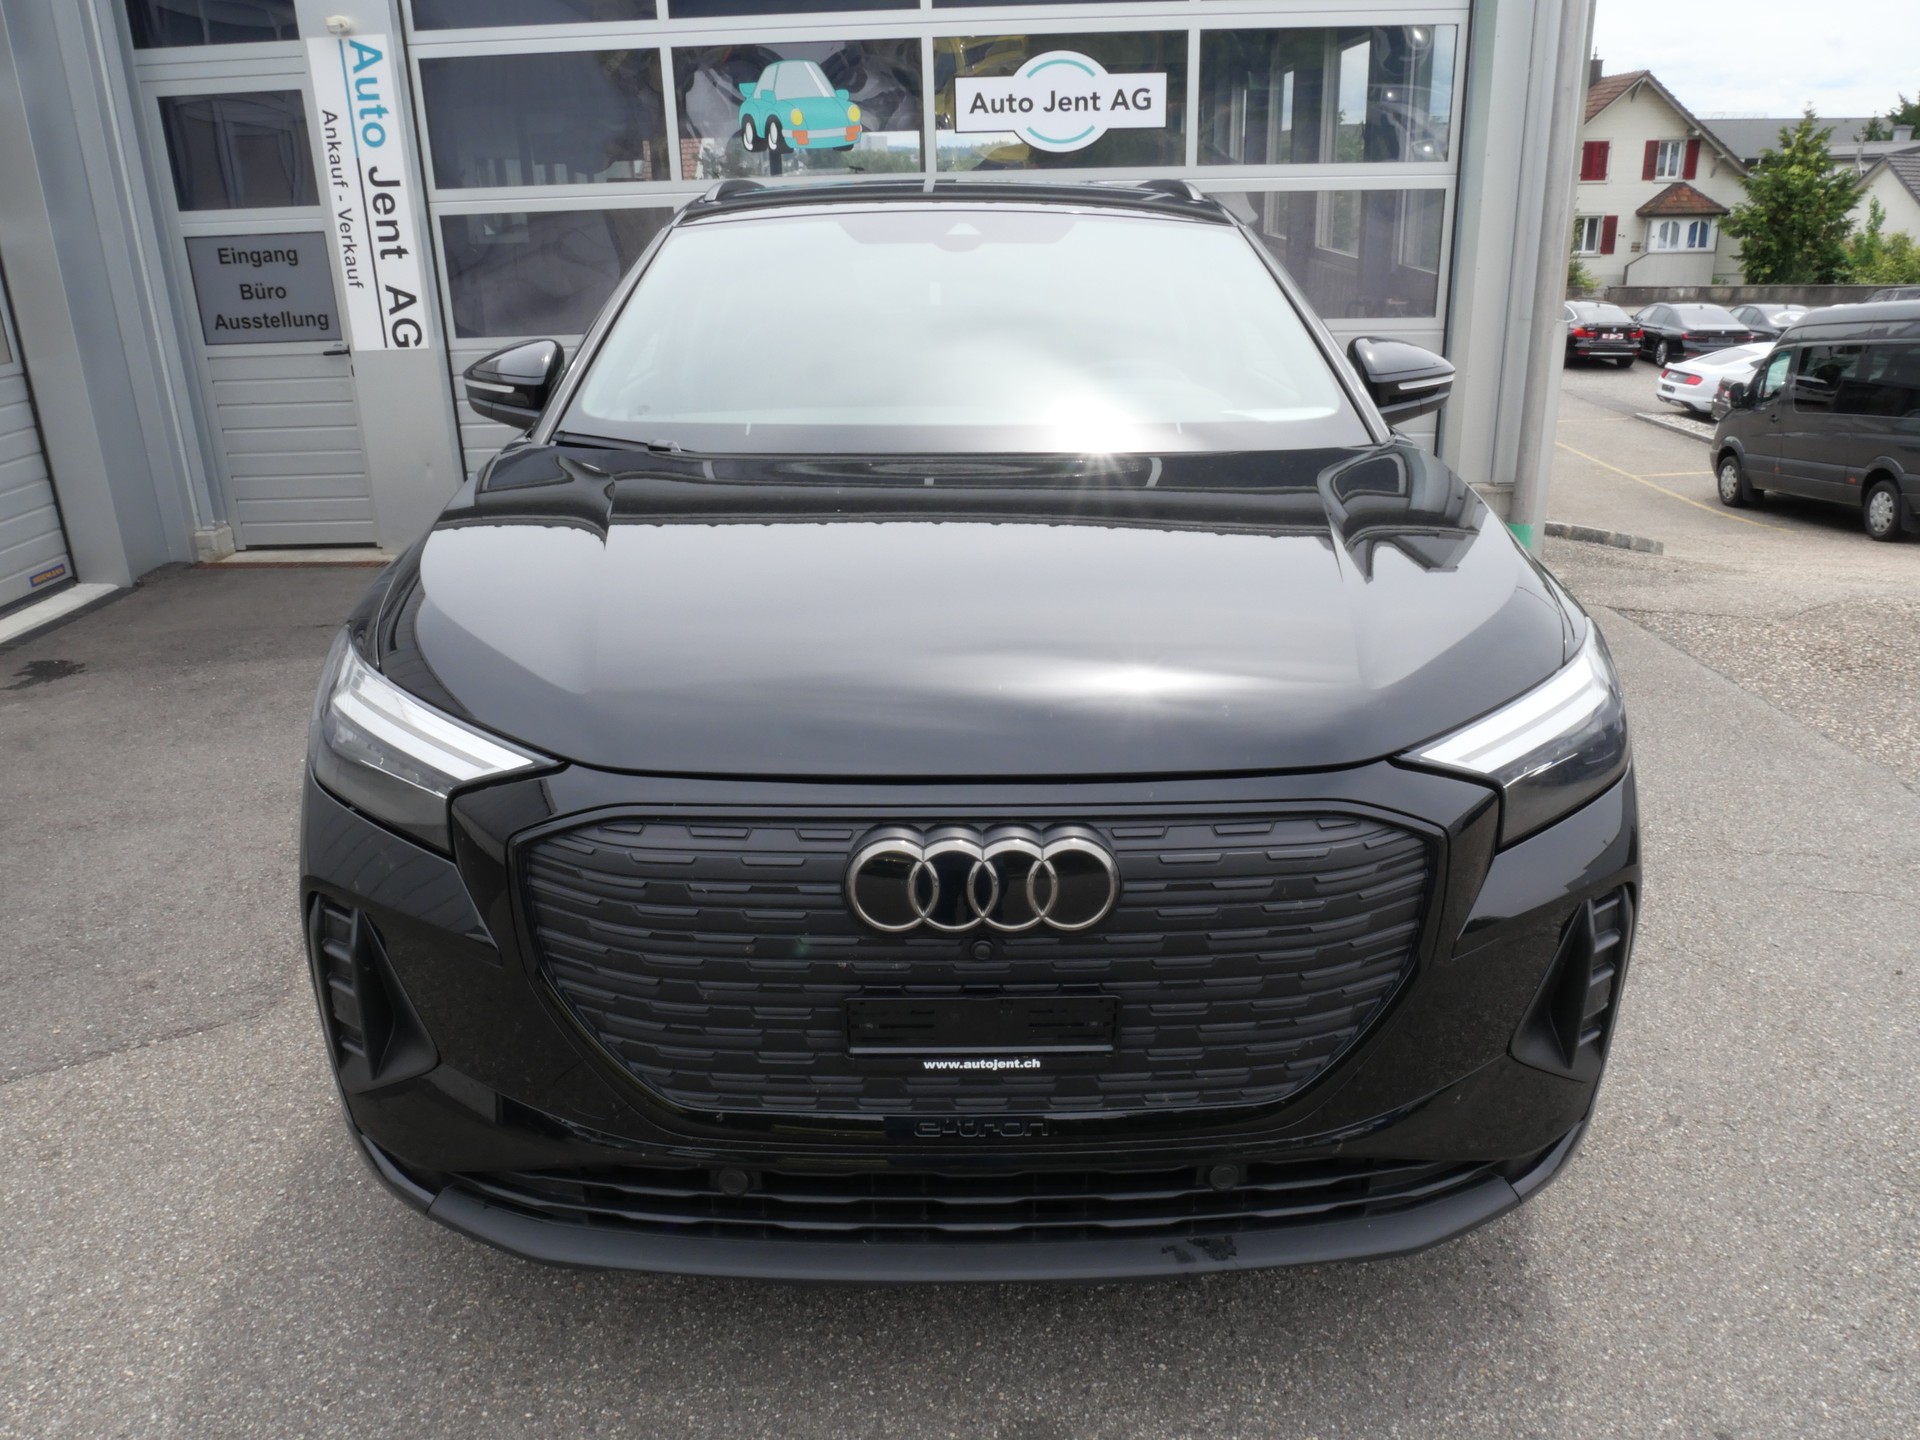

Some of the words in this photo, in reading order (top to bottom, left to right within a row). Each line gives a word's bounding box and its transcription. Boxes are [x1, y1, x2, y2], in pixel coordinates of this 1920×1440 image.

[349, 39, 390, 148] Auto
[969, 92, 1034, 114] Auto
[1043, 90, 1101, 112] Jent
[1110, 88, 1151, 111] AG
[322, 109, 349, 188] Ankauf
[338, 208, 364, 288] Verkauf
[368, 166, 410, 260] Jent
[217, 247, 299, 268] Eingang
[239, 282, 287, 300] Büro
[215, 311, 329, 331] Ausstellung
[385, 284, 423, 348] AG
[923, 1059, 1041, 1071] www.autojent.ch
